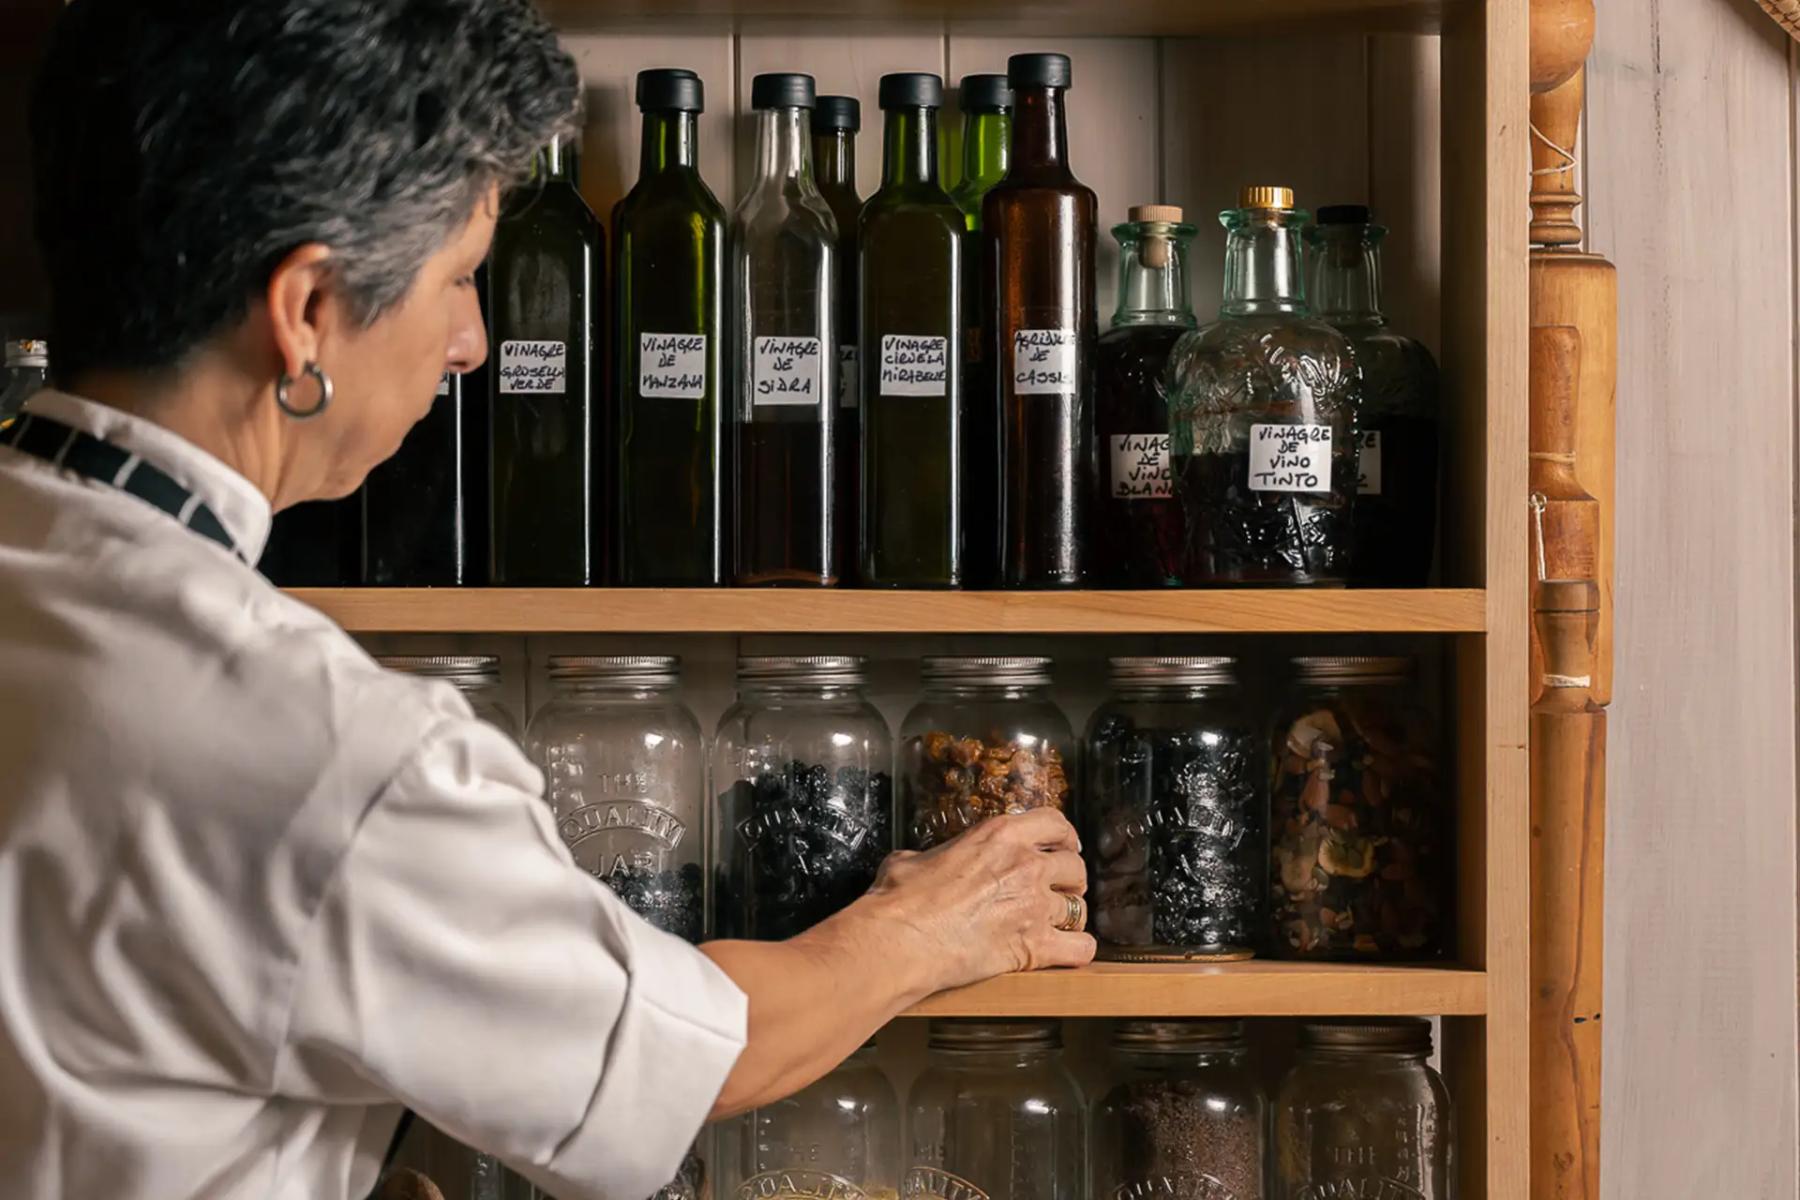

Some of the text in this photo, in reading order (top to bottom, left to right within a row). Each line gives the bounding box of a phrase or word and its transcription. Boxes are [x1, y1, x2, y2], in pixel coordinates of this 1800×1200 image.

[504, 342, 565, 360] VINAGRE
[642, 337, 703, 354] VINAGRE
[759, 339, 819, 359] VINAGRE
[885, 336, 945, 352] VINAGRE
[657, 354, 676, 368] DE
[1029, 346, 1050, 361] DE
[773, 356, 793, 371] DE
[510, 378, 556, 391] VERDE
[642, 373, 703, 390] MANZANA
[757, 377, 812, 394] SIDRA
[1258, 425, 1331, 443] VINAGRE
[1118, 434, 1170, 452] VINAG
[1277, 441, 1299, 454] DE
[1136, 452, 1160, 466] DE
[1269, 455, 1311, 469] VINO
[1254, 471, 1319, 488] TINTO
[1115, 481, 1174, 497] BLAN
[563, 803, 681, 845] QUALITY
